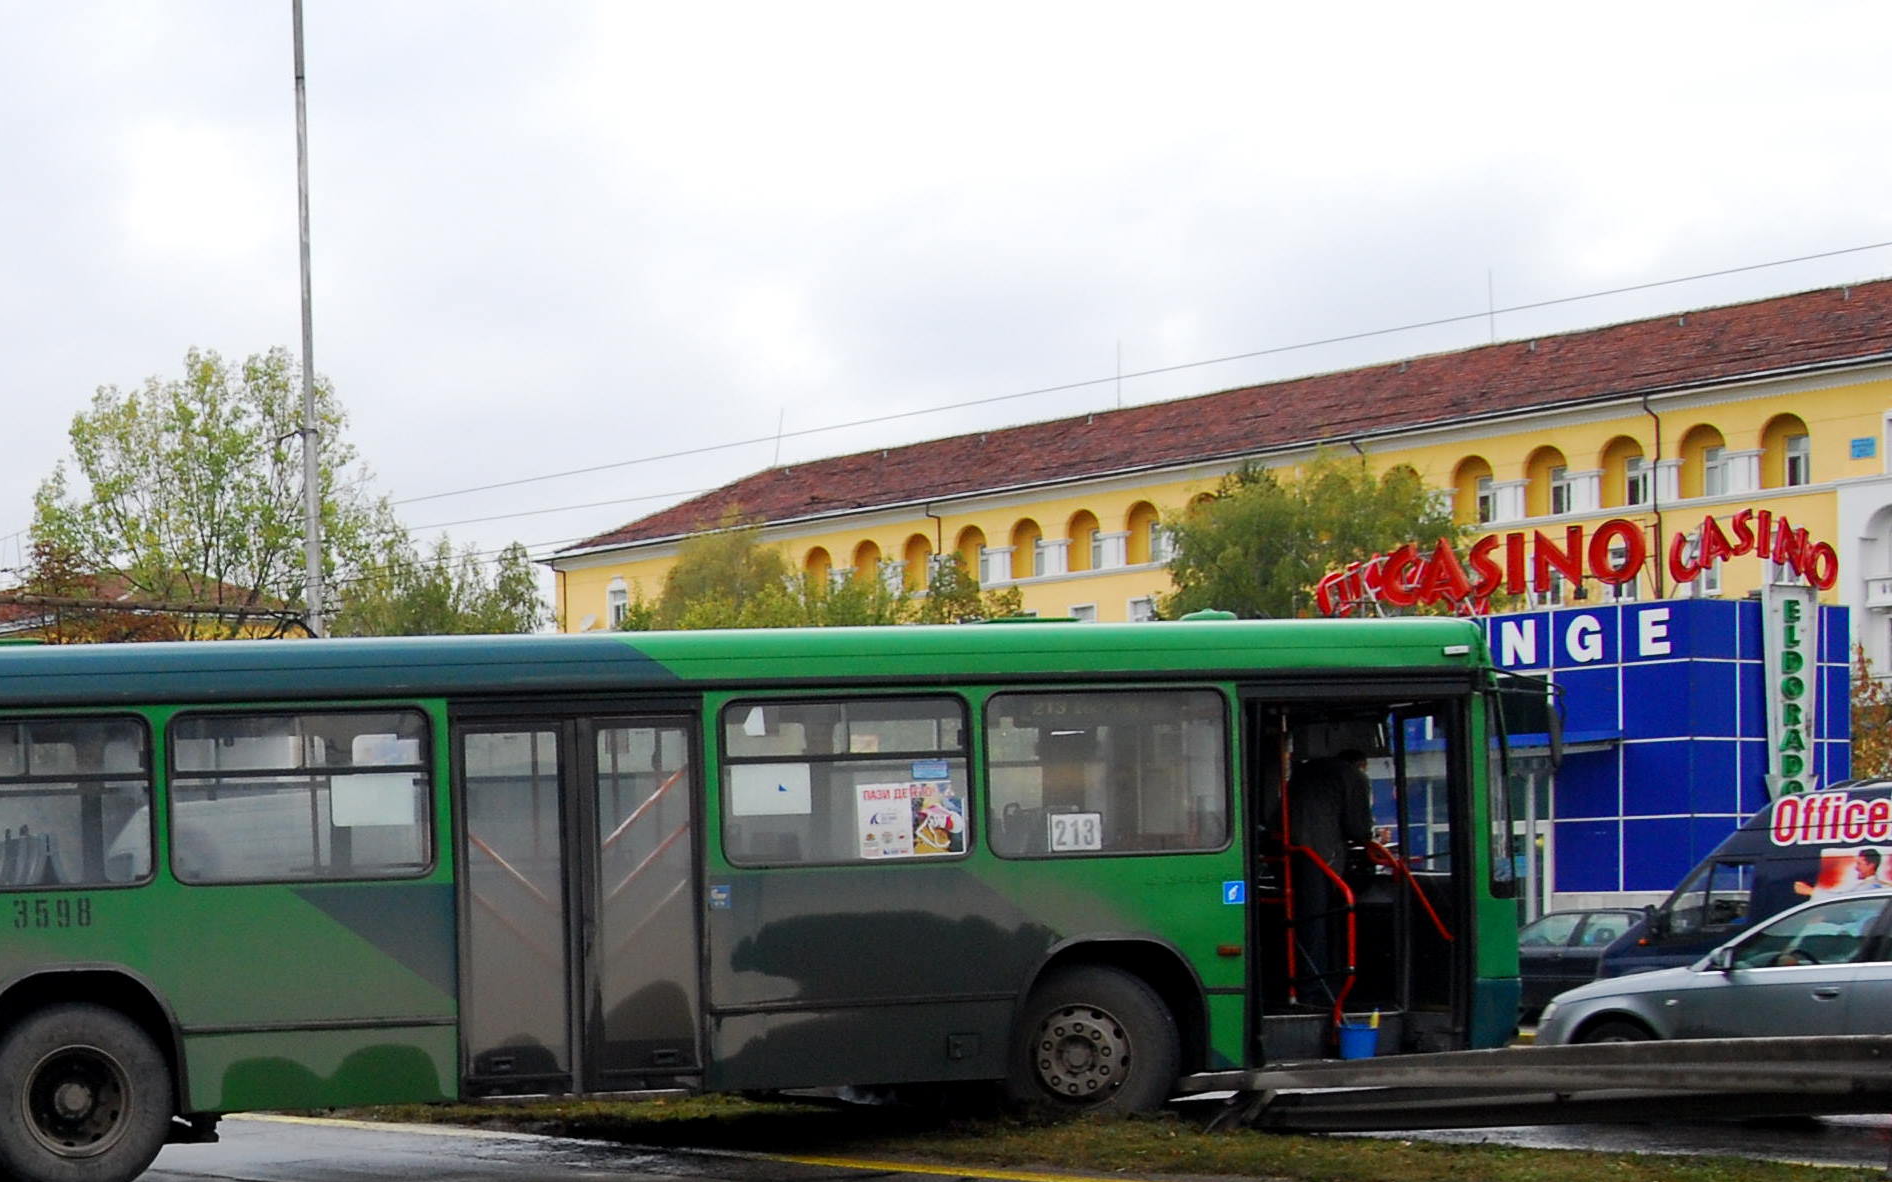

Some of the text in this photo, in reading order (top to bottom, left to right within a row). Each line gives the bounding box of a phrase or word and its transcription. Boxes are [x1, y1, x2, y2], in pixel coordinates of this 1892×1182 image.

[1379, 519, 1646, 607] CASINO
[1669, 508, 1839, 591] CASINO
[1501, 607, 1671, 666] NGE
[1055, 819, 1095, 846] 213
[13, 897, 92, 929] 3598
